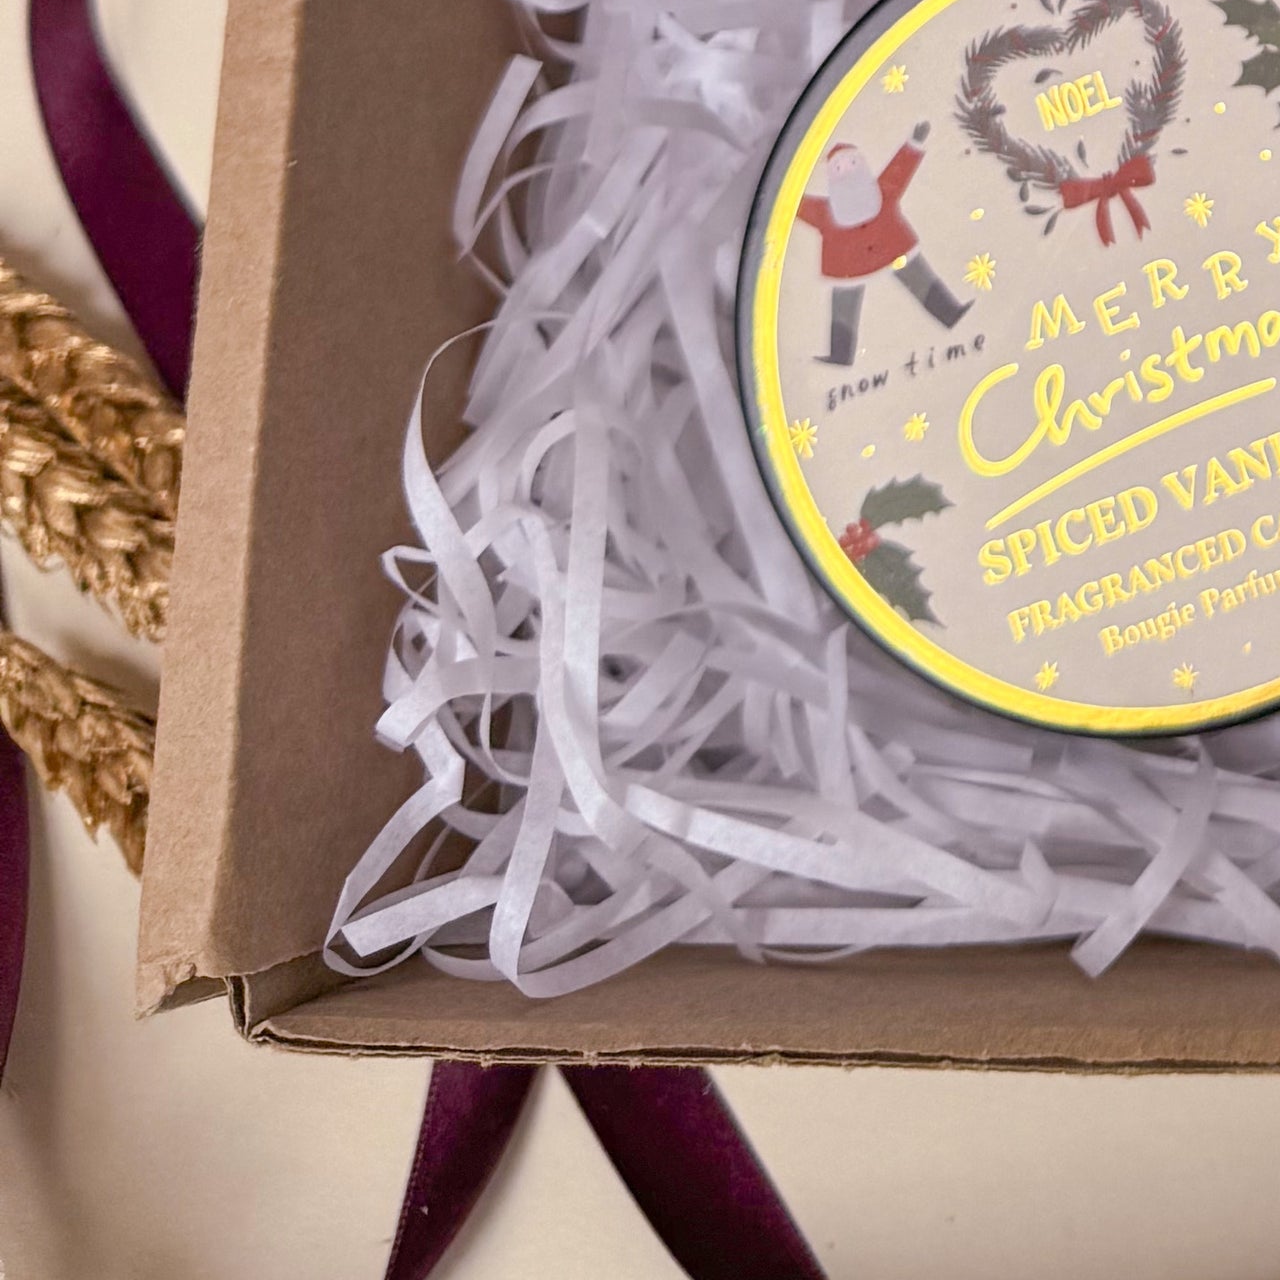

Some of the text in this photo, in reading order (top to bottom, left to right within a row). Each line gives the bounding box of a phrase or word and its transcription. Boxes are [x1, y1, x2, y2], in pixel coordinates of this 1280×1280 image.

[1035, 70, 1123, 131] NOEL
[826, 333, 986, 412] snow time
[978, 485, 1159, 586] SPICED
[1007, 528, 1247, 642] FRAGRANCED
[1099, 601, 1196, 657] Bougie
